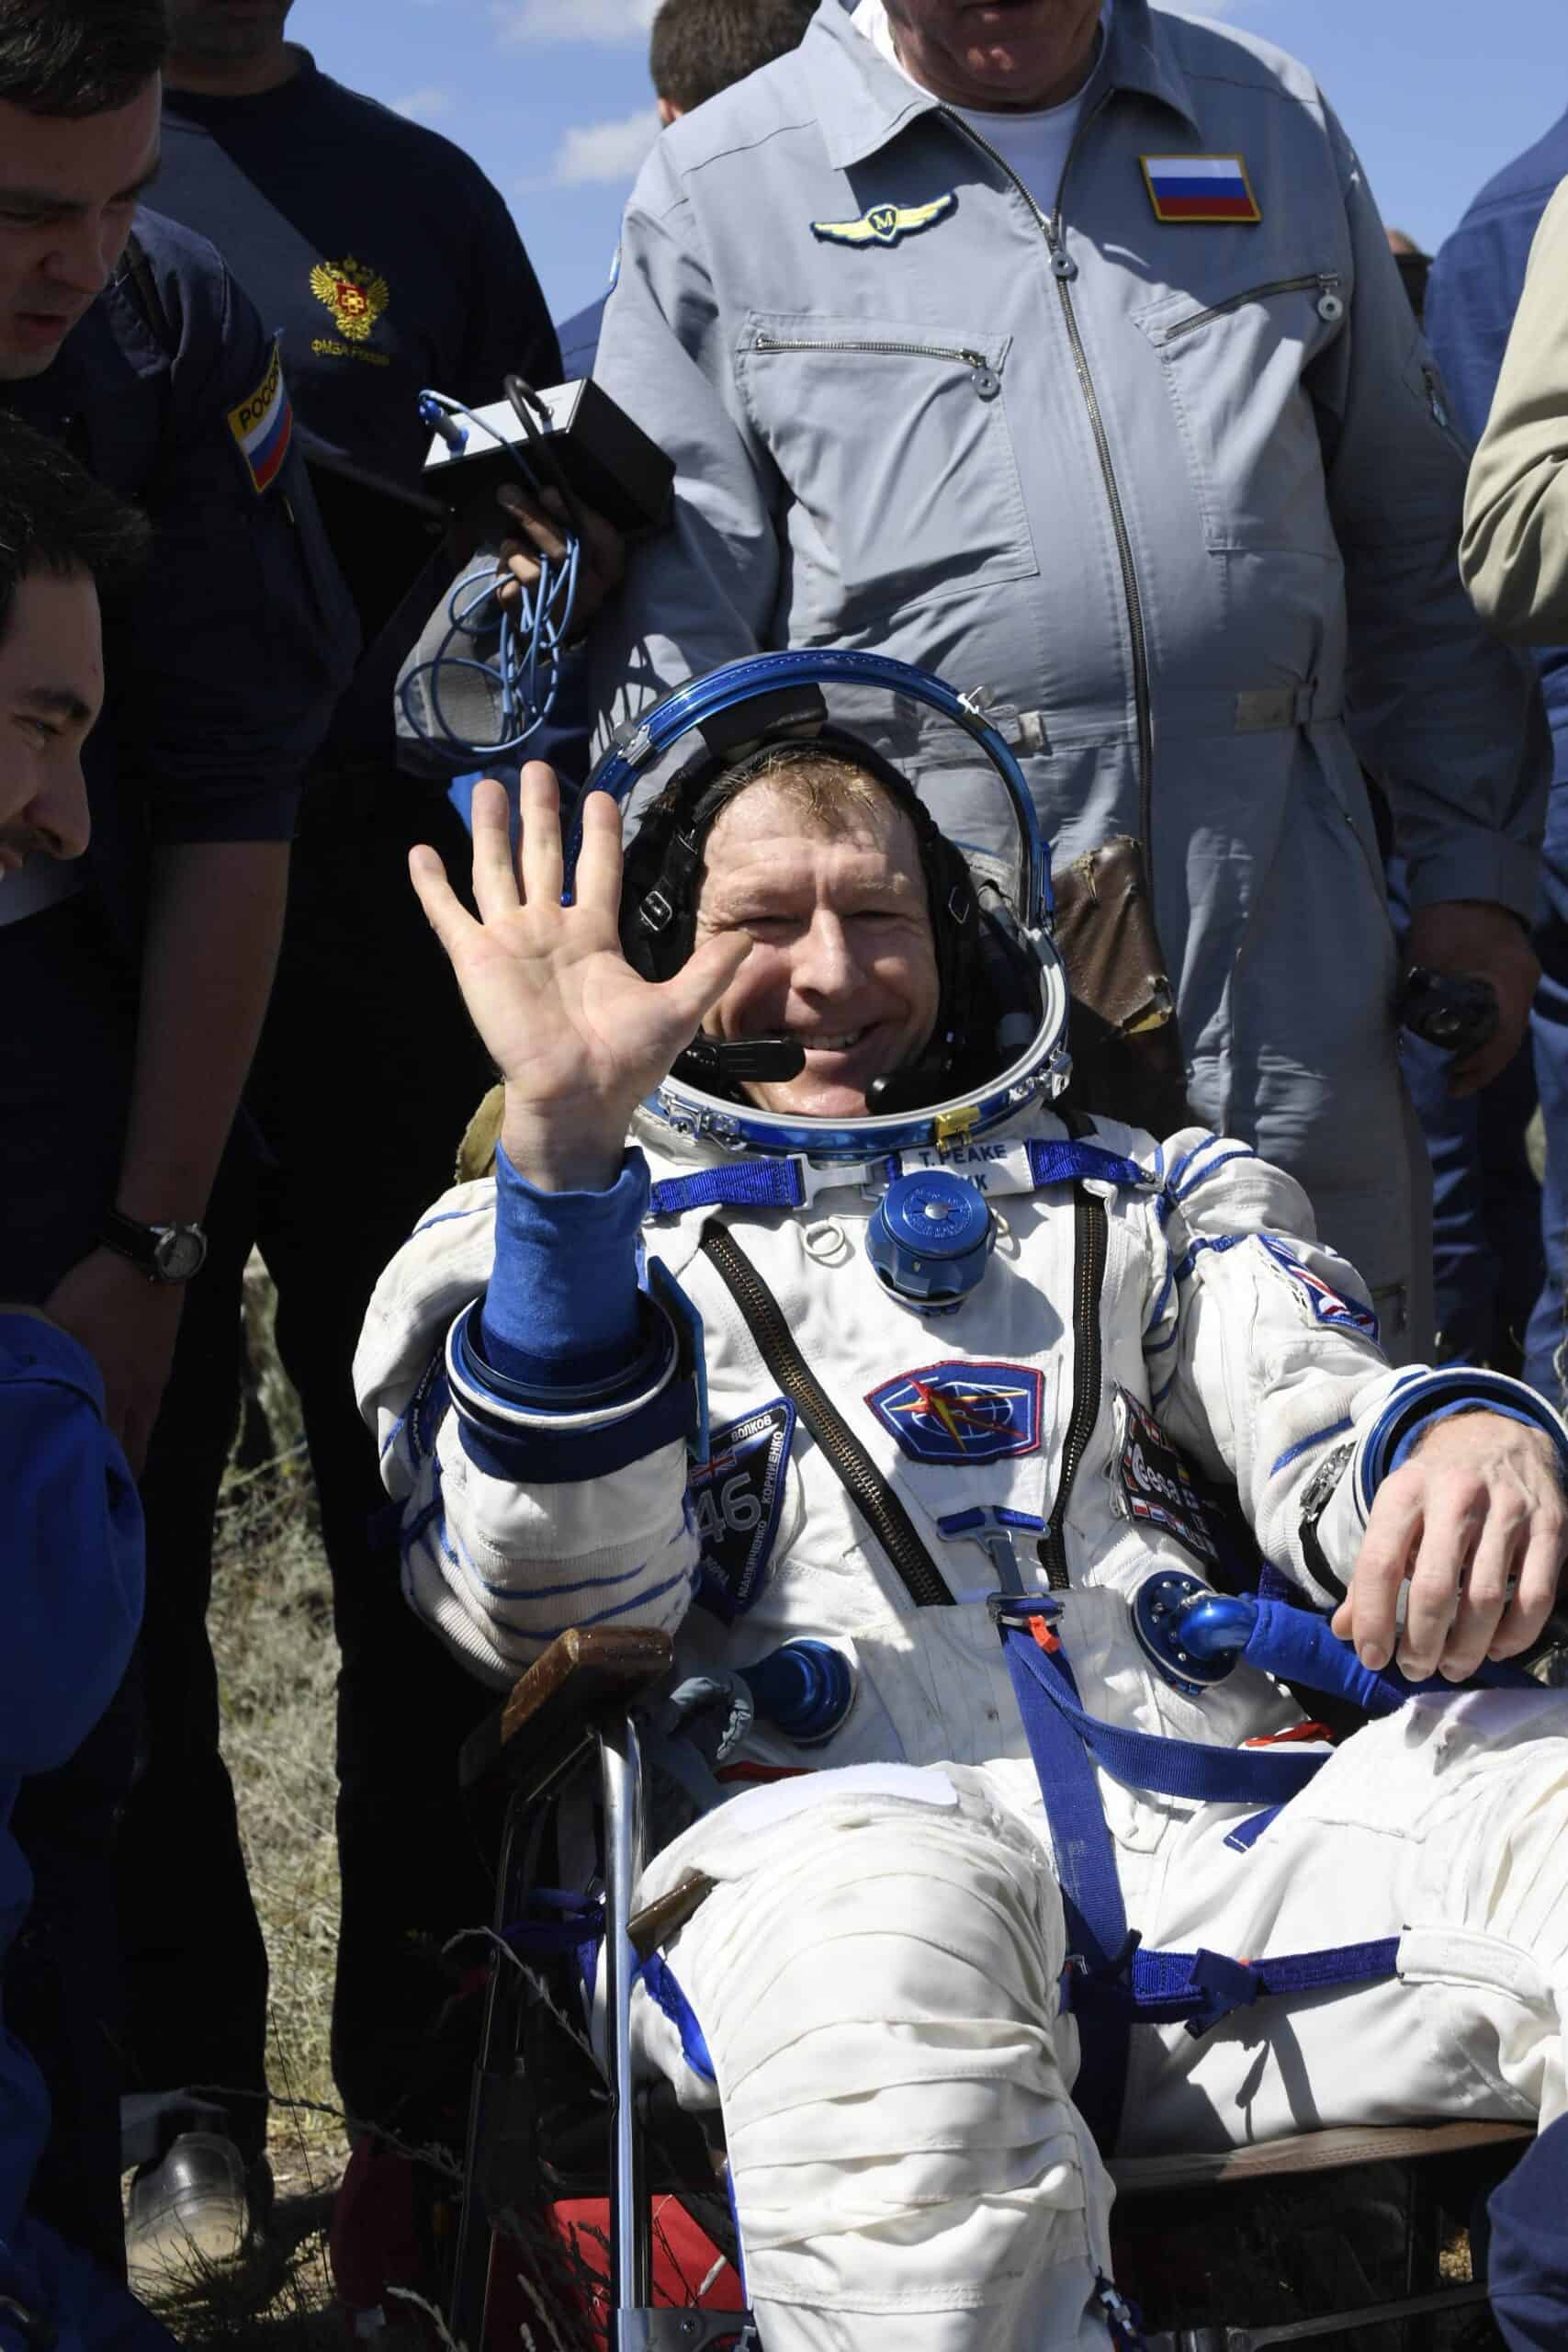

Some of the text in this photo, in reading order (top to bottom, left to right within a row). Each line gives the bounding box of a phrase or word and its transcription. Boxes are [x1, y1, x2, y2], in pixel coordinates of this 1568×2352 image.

[939, 1145, 1008, 1165] PEAKE
[731, 1415, 773, 1442] ВОЛКОВ
[761, 1430, 784, 1504] КОРНИЕНКО
[695, 1471, 761, 1543] 46
